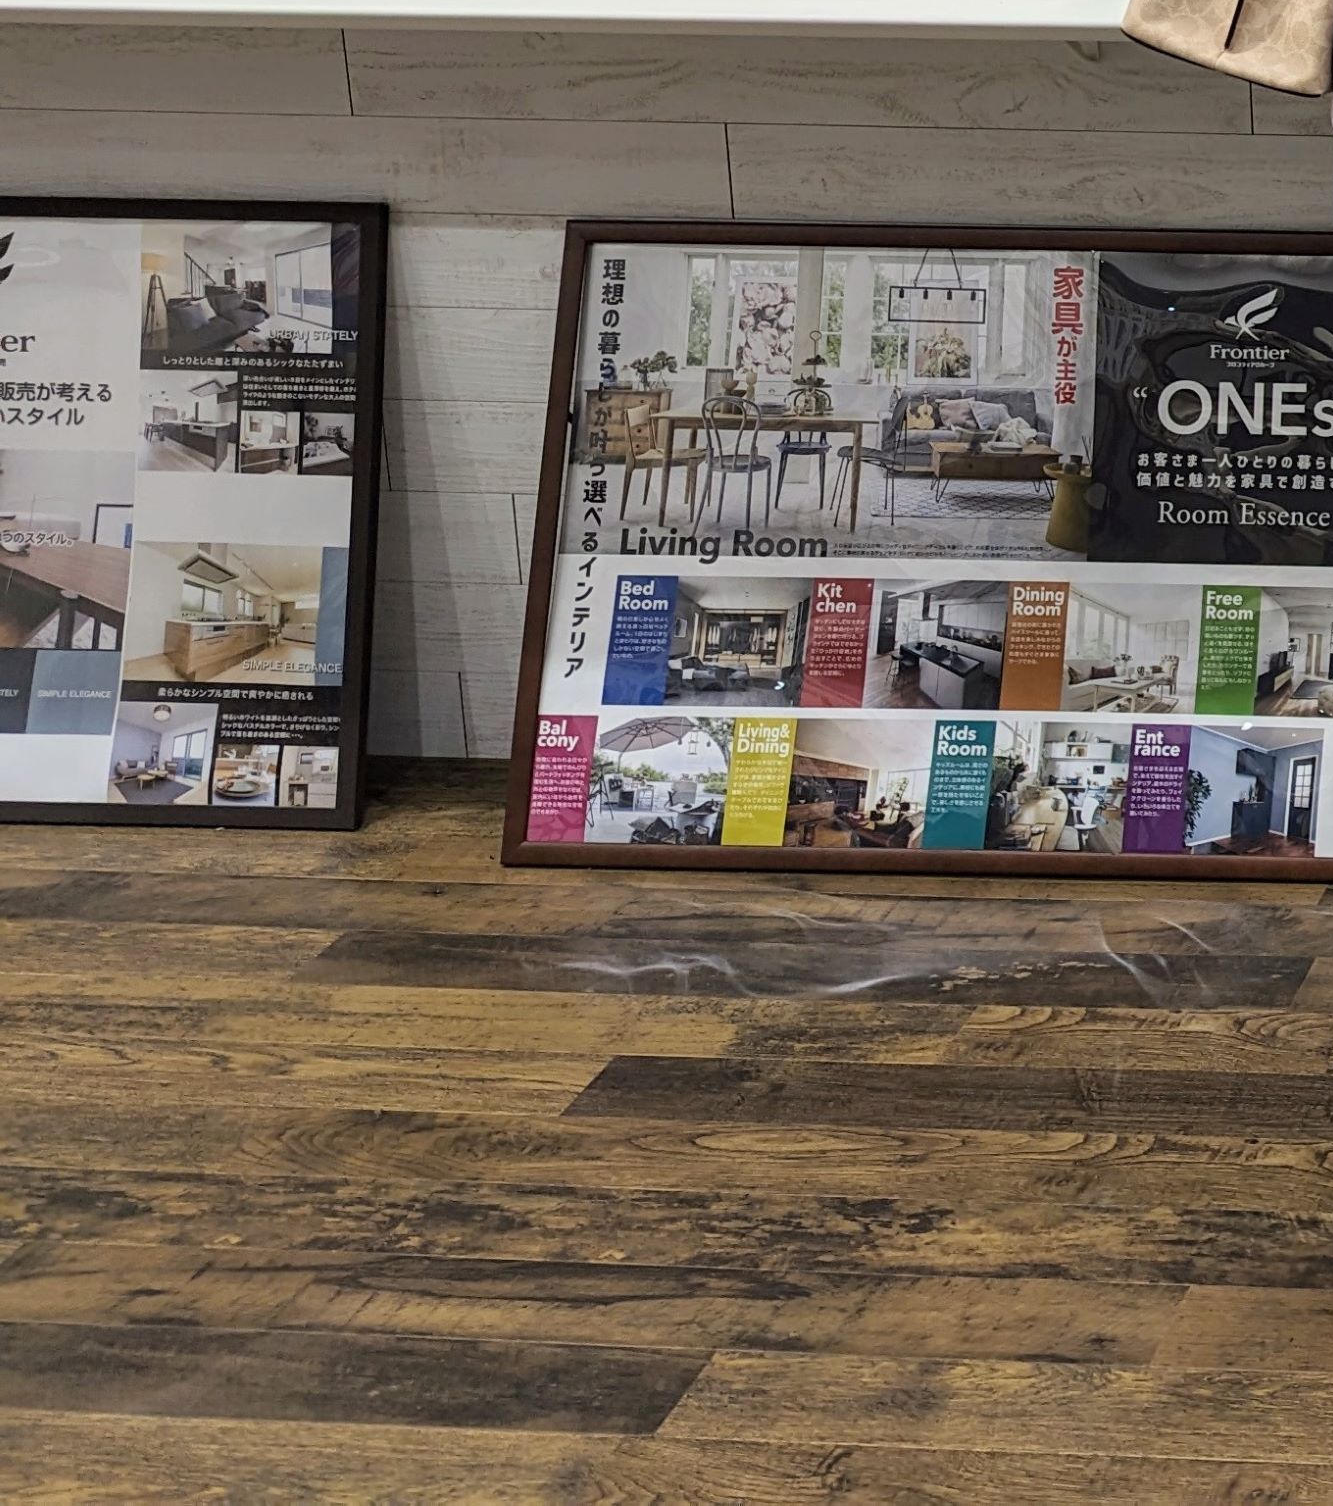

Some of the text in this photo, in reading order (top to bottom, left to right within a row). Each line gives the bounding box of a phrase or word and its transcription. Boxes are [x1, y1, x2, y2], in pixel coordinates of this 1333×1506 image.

[269, 330, 359, 342] URBAN STATELY
[1052, 266, 1084, 405] 家具が主役
[1209, 344, 1290, 361] Frontier
[1158, 501, 1330, 527] Room Essence
[620, 527, 721, 564] Living
[733, 529, 828, 557] Room
[621, 580, 655, 596] Bed
[818, 582, 843, 598] Kit
[618, 596, 669, 611] Room
[1013, 587, 1065, 606] Dining
[1207, 590, 1243, 606] Free
[816, 597, 857, 613] chen
[1013, 601, 1062, 617] Room
[1206, 605, 1254, 621] Room
[242, 660, 343, 674] SIMPLE ELEGANCE
[539, 720, 566, 736] Bal
[739, 723, 790, 741] Living&
[939, 725, 977, 741] Kids
[537, 734, 579, 752] cony
[1136, 729, 1164, 744] Ent
[737, 738, 789, 757] Dining
[937, 740, 987, 757] Room
[1135, 743, 1181, 757] rance
